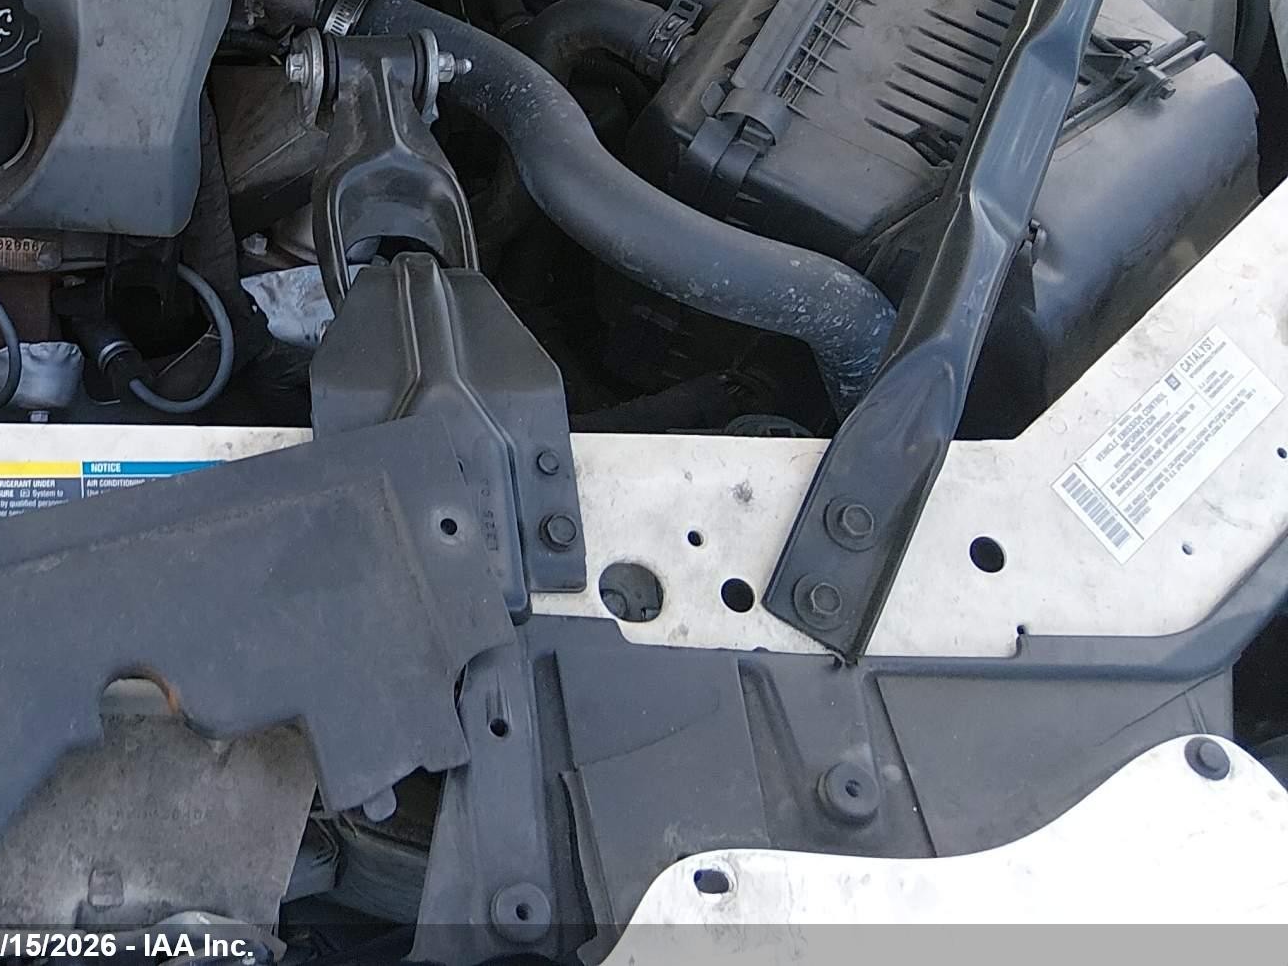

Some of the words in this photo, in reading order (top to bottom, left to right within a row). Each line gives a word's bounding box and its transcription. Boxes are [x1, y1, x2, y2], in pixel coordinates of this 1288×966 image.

[1180, 337, 1215, 373] CATALYST
[1097, 440, 1119, 462] VEHICLE
[1118, 415, 1143, 440] EMISSION
[1142, 392, 1166, 416] CONTROL
[1120, 414, 1157, 450] INFORMATION
[90, 463, 121, 473] NOTICE
[33, 479, 56, 488] UNDER
[86, 479, 98, 487] AIR
[32, 489, 56, 498] System
[0, 500, 8, 509] by
[9, 499, 37, 509] qualified
